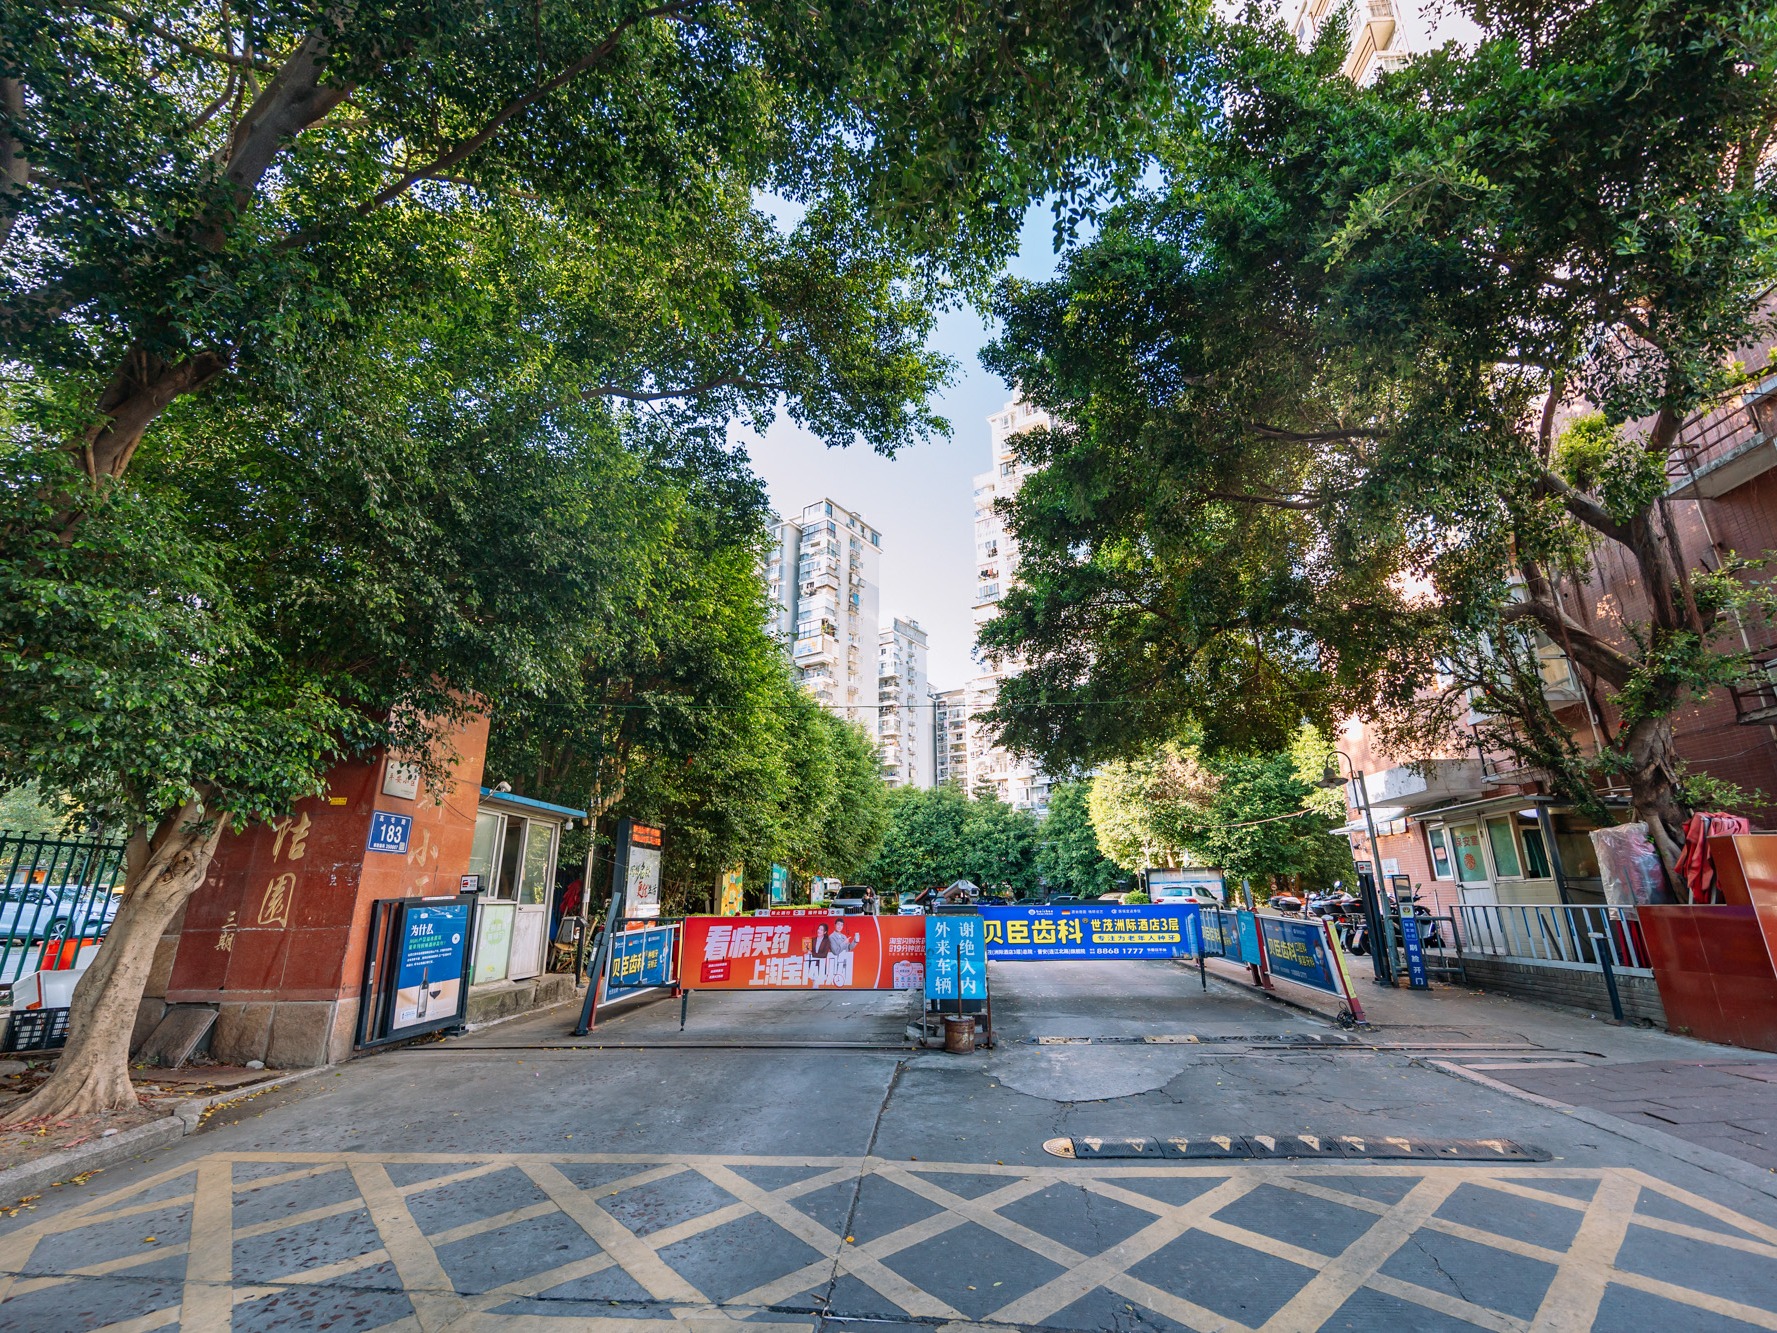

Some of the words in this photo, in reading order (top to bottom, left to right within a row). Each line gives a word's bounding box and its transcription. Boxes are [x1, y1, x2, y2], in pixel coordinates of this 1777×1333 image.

[380, 823, 403, 844] 183
[410, 923, 434, 942] 为什么
[984, 918, 1083, 945] 贝臣齿科
[1090, 918, 1180, 932] 世茂洲际酒店3层
[704, 925, 791, 961] 看病买药
[1096, 947, 1120, 955] 8868
[1122, 947, 1144, 955] 1777
[1267, 938, 1297, 962] 贝臣齿科
[748, 951, 854, 988] 上淘宝闪购
[935, 922, 951, 995] 外来车辆
[959, 922, 976, 995] 谢绝入内
[1409, 944, 1424, 985] 刷脸开门
